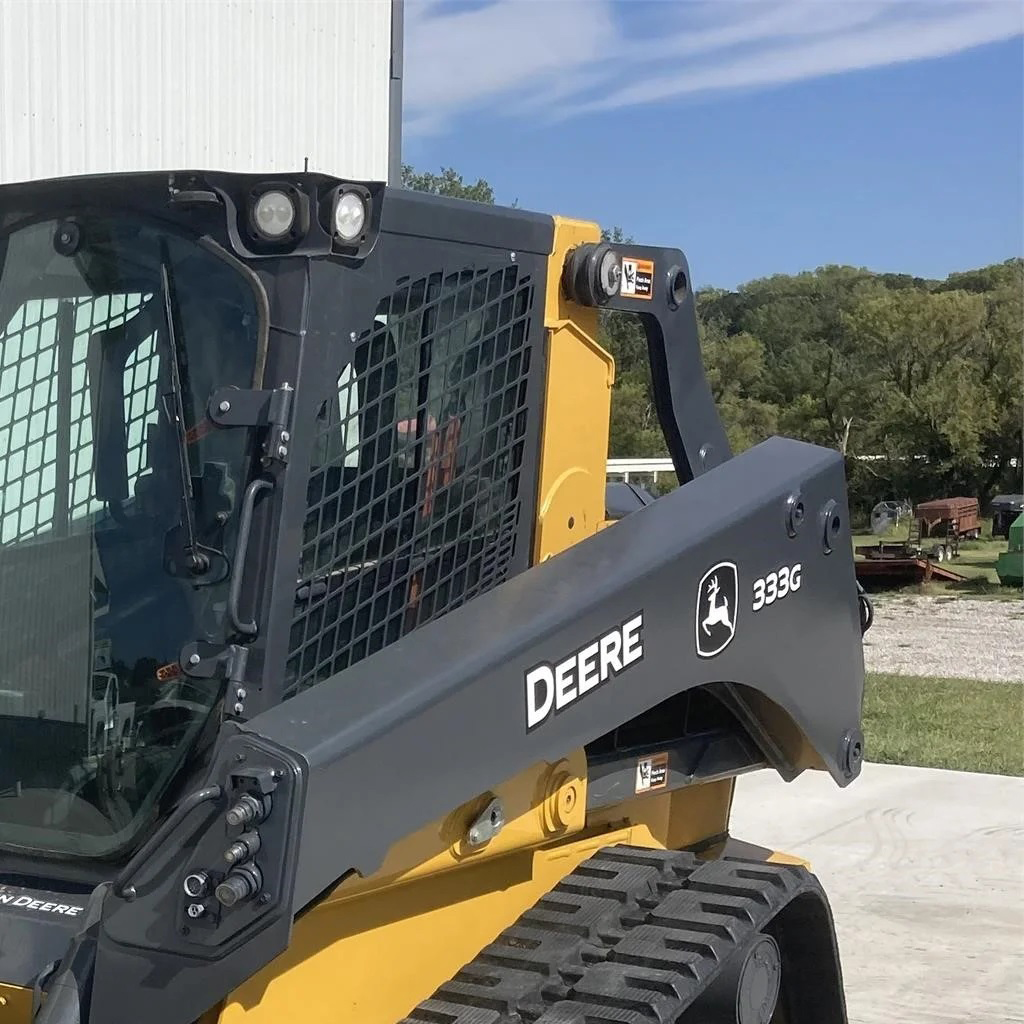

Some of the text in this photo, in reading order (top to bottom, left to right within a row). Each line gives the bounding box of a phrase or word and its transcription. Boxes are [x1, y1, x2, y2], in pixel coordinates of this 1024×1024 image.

[752, 564, 802, 611] 333G
[526, 614, 643, 728] DEERE
[13, 896, 84, 916] DEERE
